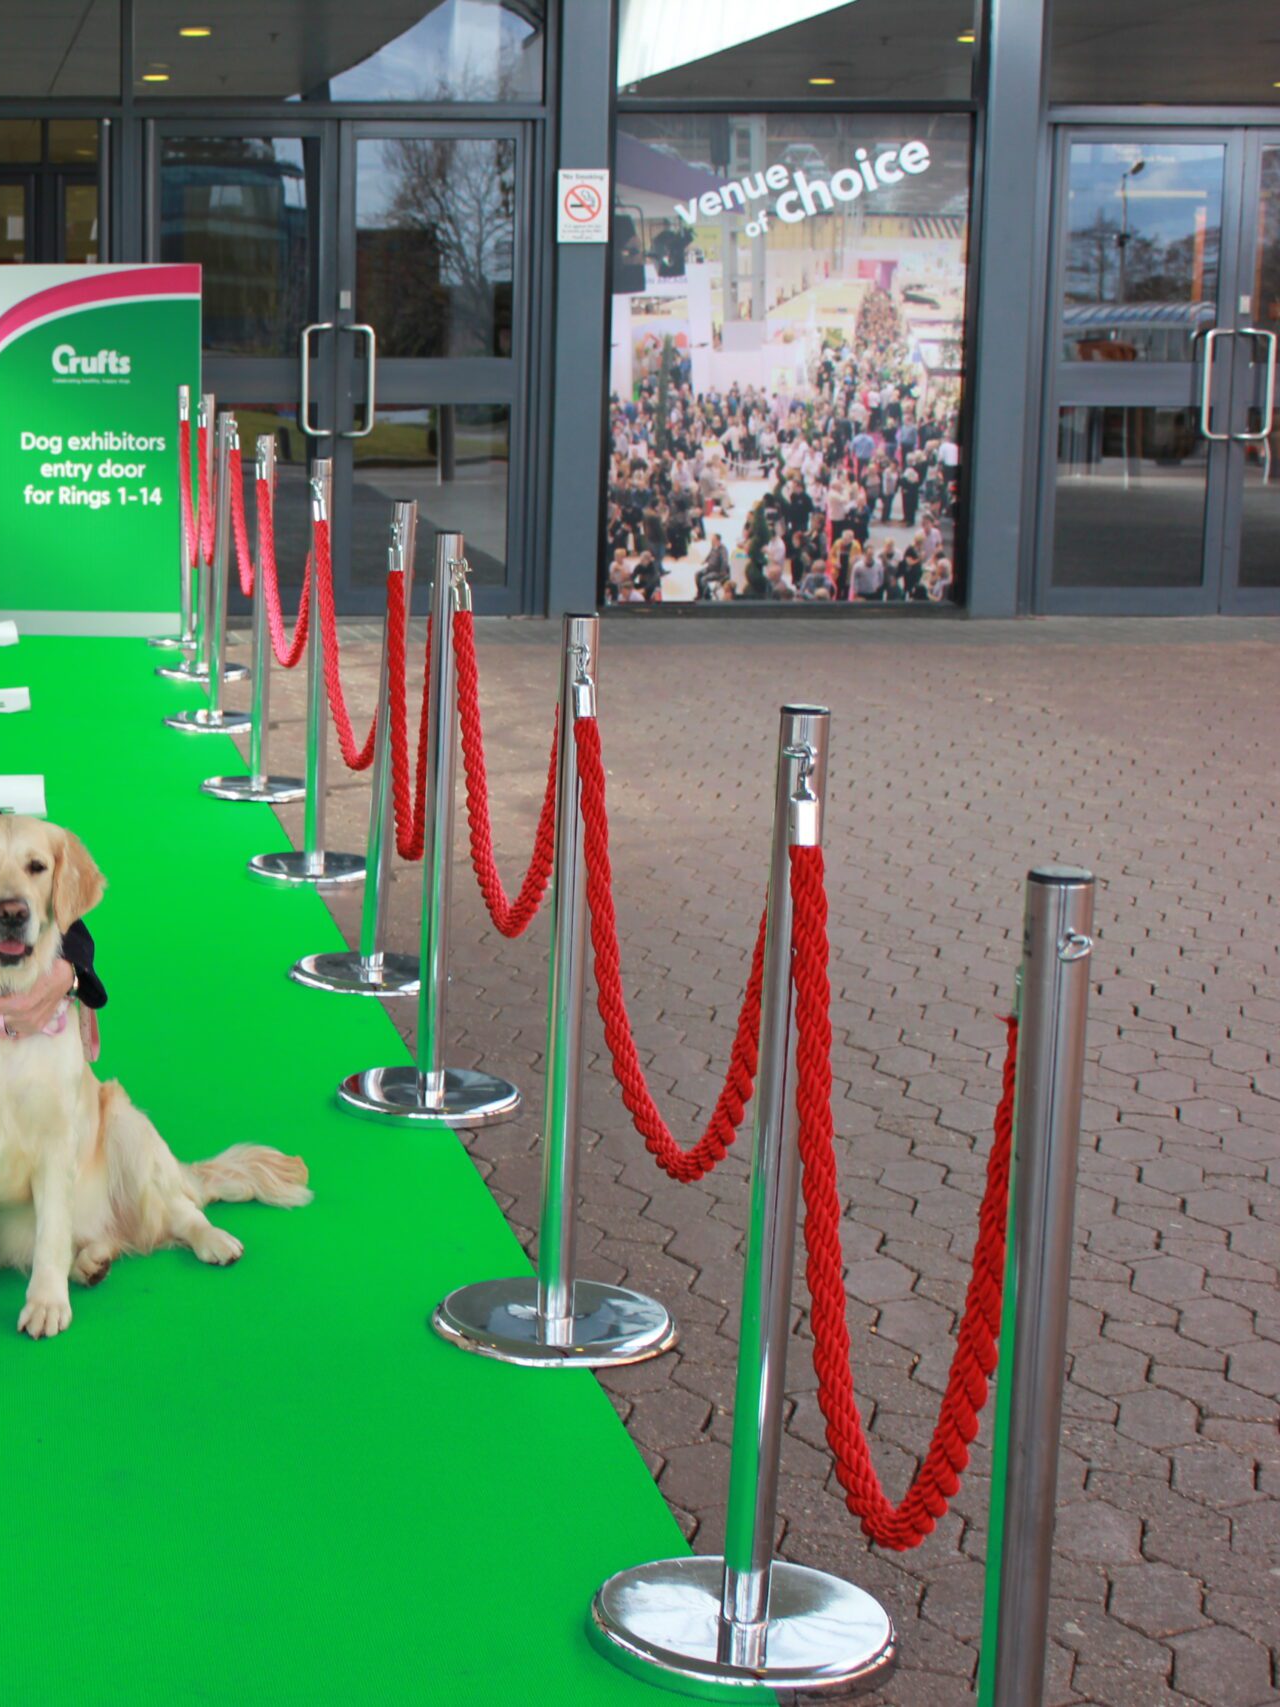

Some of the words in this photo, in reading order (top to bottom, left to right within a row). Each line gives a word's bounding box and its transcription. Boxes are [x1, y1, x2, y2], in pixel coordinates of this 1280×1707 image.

[674, 164, 790, 225] venue
[745, 210, 769, 238] of
[776, 141, 932, 223] choice
[52, 344, 131, 375] Crufts
[20, 431, 63, 455] Dog
[67, 431, 166, 452] exhibitors
[40, 459, 93, 483] entry
[97, 458, 147, 479] door
[23, 484, 54, 505] for
[58, 485, 112, 510] Rings
[117, 486, 163, 506] 1-14
